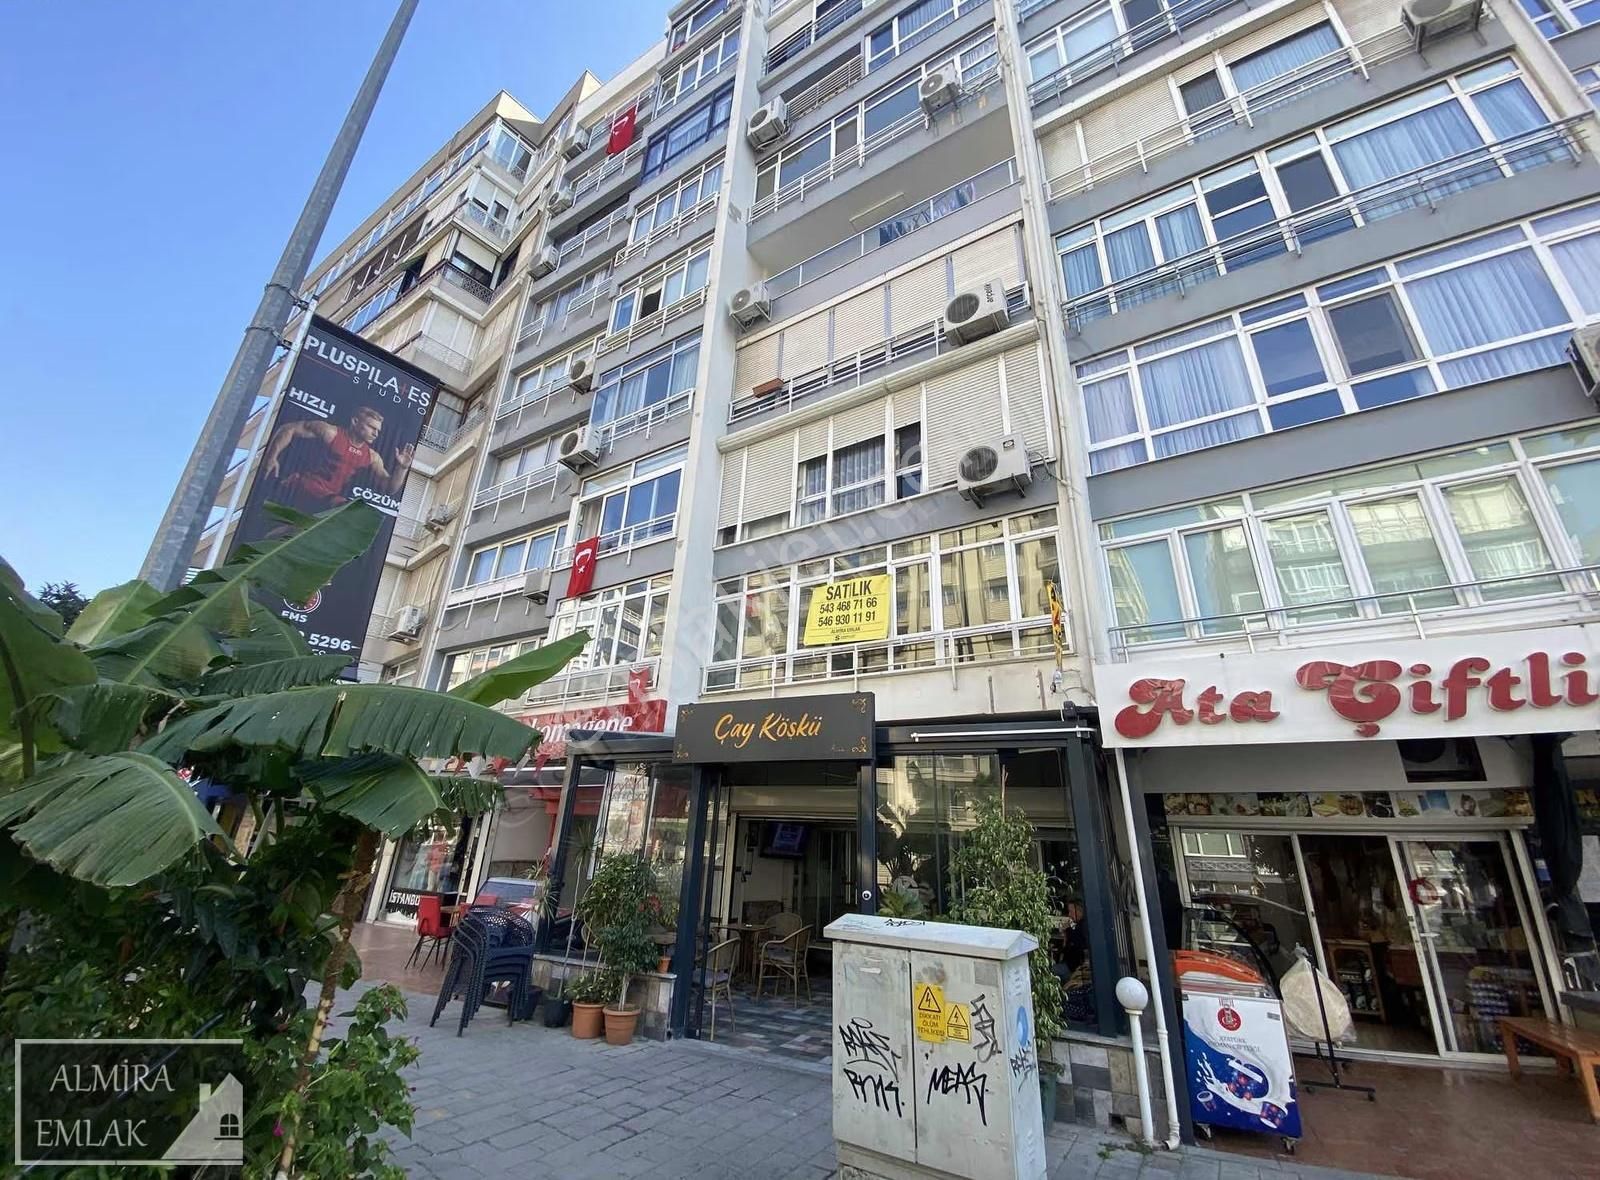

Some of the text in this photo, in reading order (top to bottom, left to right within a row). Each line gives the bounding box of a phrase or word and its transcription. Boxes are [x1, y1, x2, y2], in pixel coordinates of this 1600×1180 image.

[288, 386, 336, 415] HIZLI
[352, 376, 427, 416] STUDIO
[351, 486, 401, 510] ÇÖZÜM
[826, 579, 873, 601] SATILIK
[819, 596, 878, 614] 543 468 71 66
[817, 610, 876, 627] 546 930 11 91
[1114, 676, 1280, 740] Ata
[713, 711, 824, 750] Çay Köşkü
